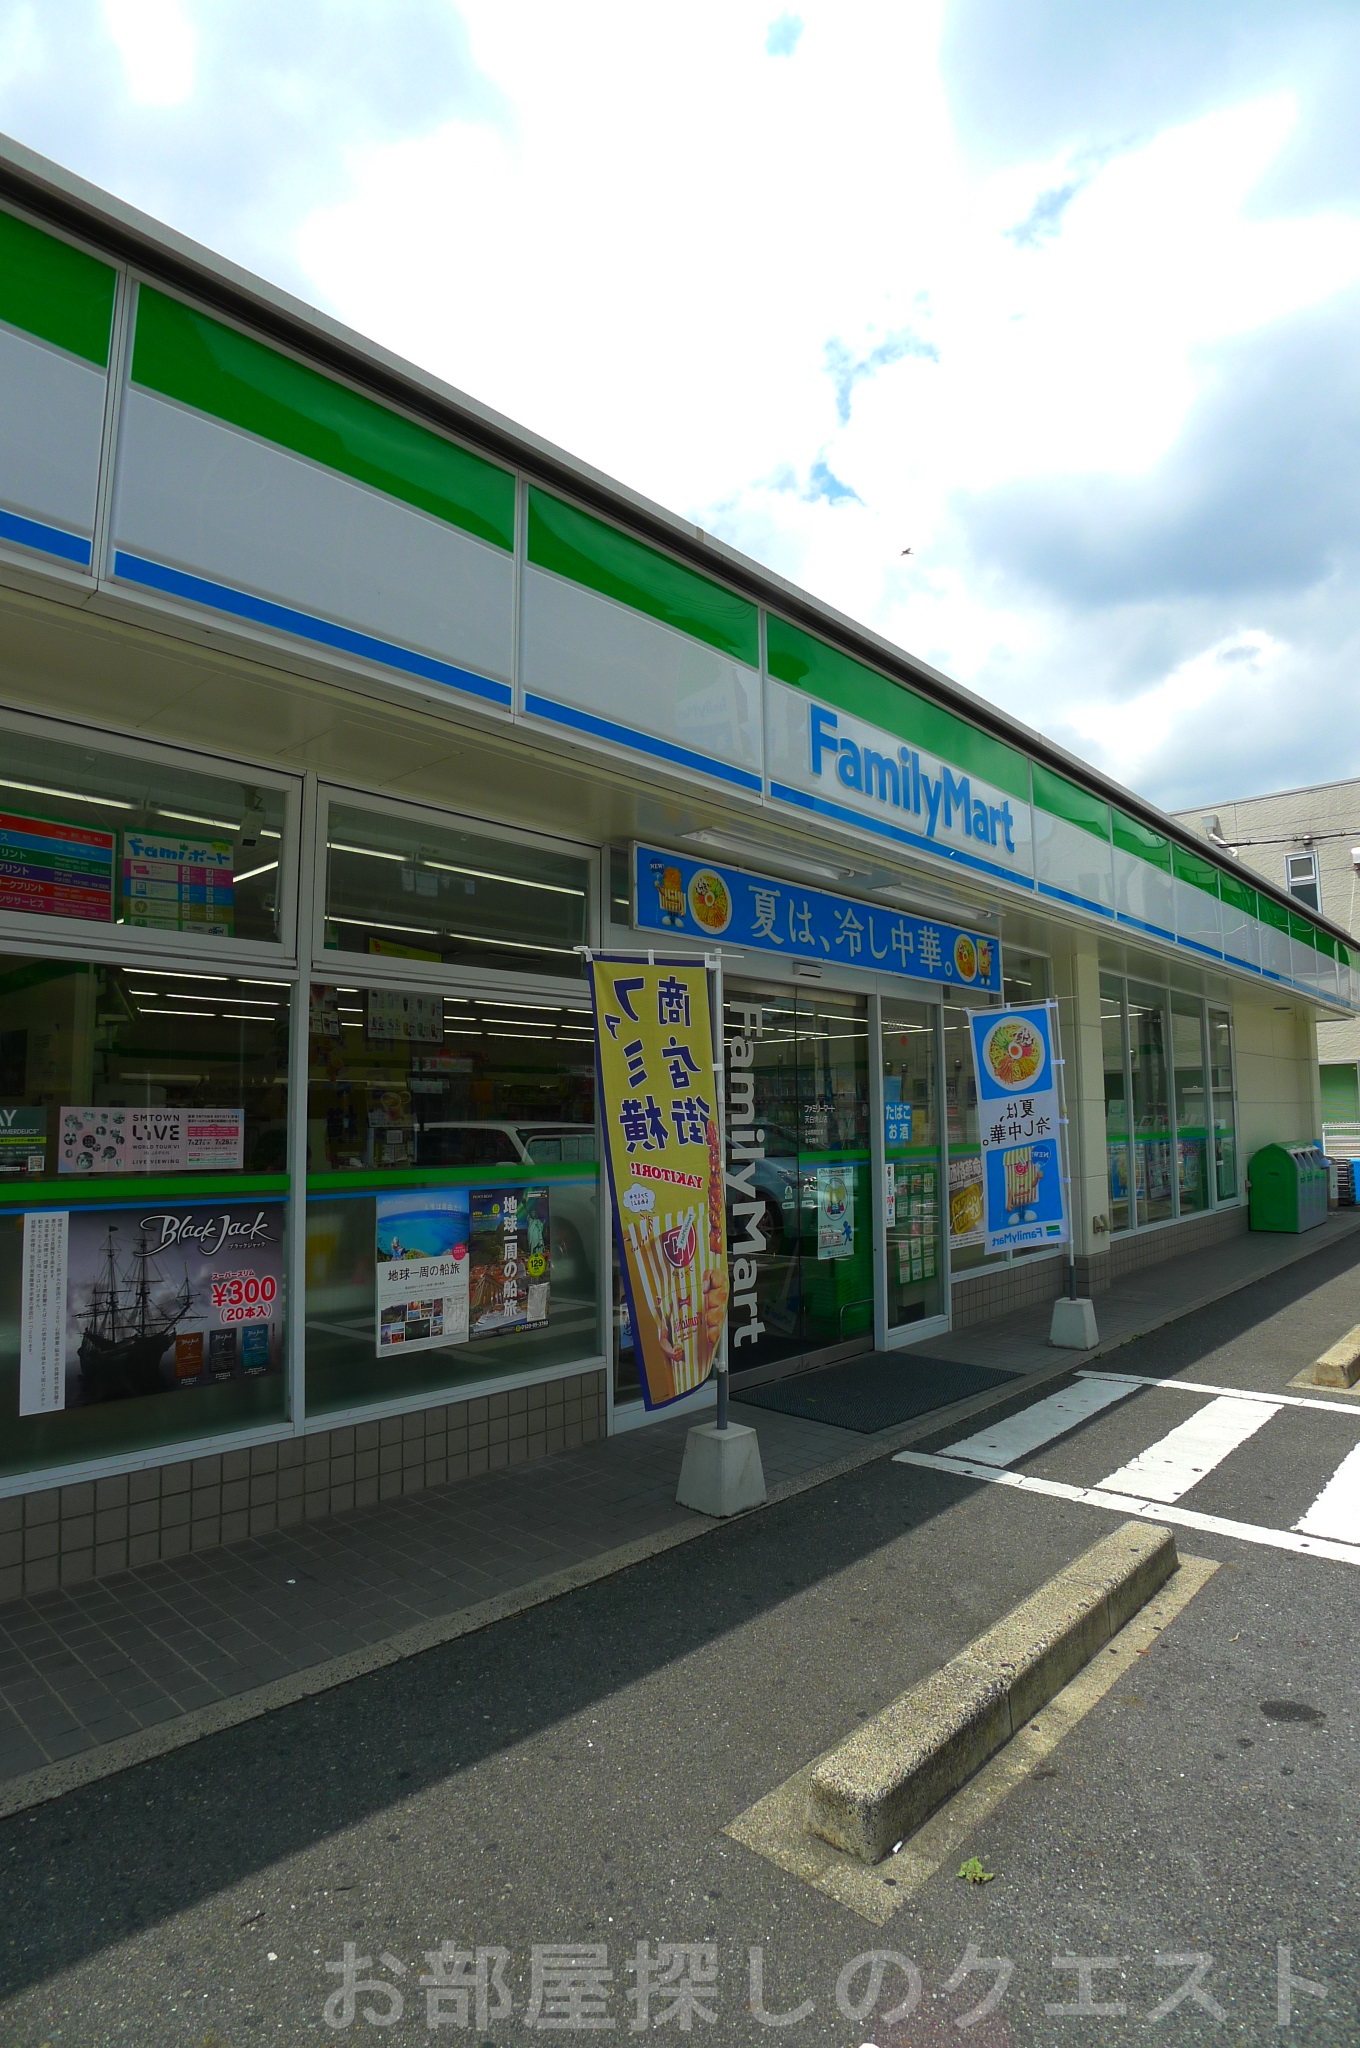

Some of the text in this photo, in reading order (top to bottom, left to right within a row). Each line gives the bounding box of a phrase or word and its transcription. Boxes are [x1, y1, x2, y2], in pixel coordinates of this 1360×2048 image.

[810, 703, 1014, 853] FamilyMart
[0, 847, 27, 860] リント
[128, 837, 230, 865] Famiポート
[747, 885, 953, 977] 夏は、冷し中華。
[132, 1114, 180, 1122] SMTOWN
[804, 1105, 835, 1113] ファミリーマート
[886, 1104, 911, 1120] たばこ
[888, 1123, 909, 1140] お酒
[724, 1000, 765, 1350] FamilyMart
[134, 1211, 277, 1257] Black Jack
[502, 1196, 518, 1317] 地球一周の船旅
[530, 1259, 543, 1268] 129
[212, 1270, 255, 1280] スーパースリム
[387, 1262, 461, 1282] 地球一周の船旅
[212, 1277, 276, 1307] ¥300
[221, 1303, 272, 1323] (20本入)
